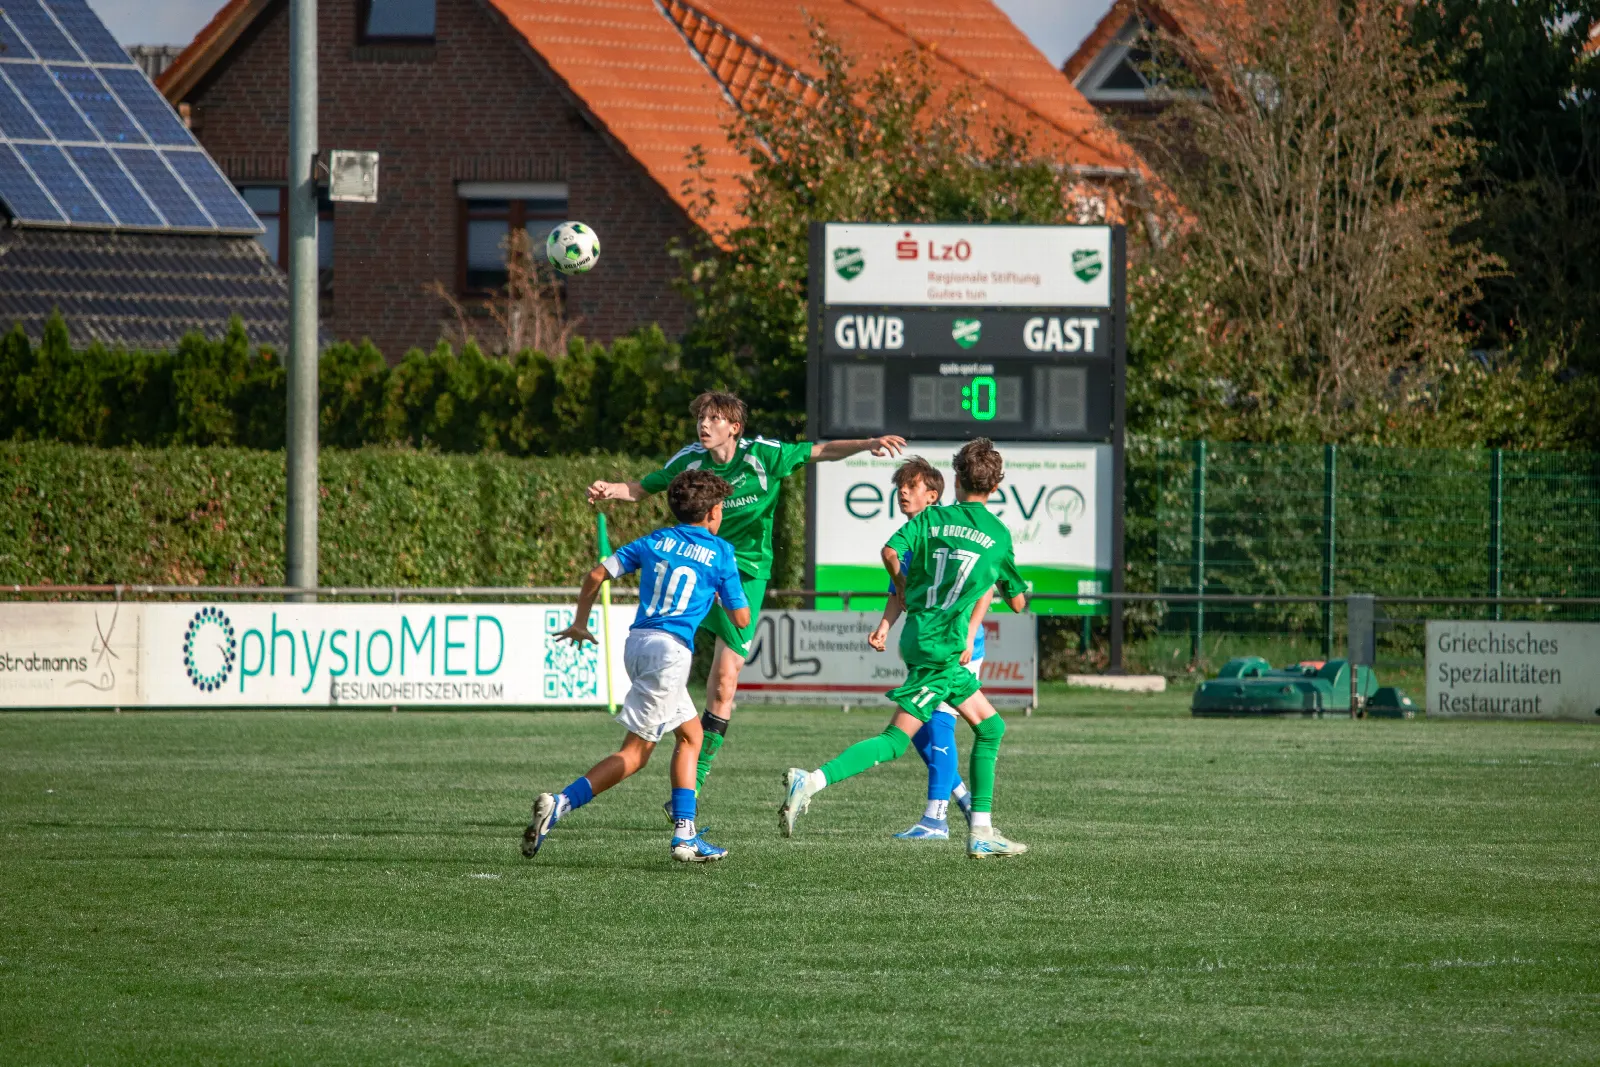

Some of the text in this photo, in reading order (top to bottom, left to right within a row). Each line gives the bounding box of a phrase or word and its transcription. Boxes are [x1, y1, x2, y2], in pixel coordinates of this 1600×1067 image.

[928, 271, 1041, 286] Regionale Stiftung
[927, 288, 987, 300] Gutes tun
[835, 315, 904, 349] GWB
[1023, 317, 1099, 352] GAST
[722, 494, 759, 509] RMANN
[943, 525, 996, 549] BROCKDORF
[676, 541, 717, 567] LOHNE
[645, 560, 697, 617] 10
[925, 548, 981, 611] 17
[801, 620, 873, 634] Motorgeräte
[240, 612, 504, 693] physioMED
[1438, 630, 1559, 655] Griechisches
[871, 666, 905, 679] JOHN
[979, 662, 1025, 681] TIHL
[1438, 661, 1562, 689] Spezialitäten
[330, 682, 504, 700] GESUNDHEITSZENTRUM
[1438, 692, 1542, 714] Restaurant
